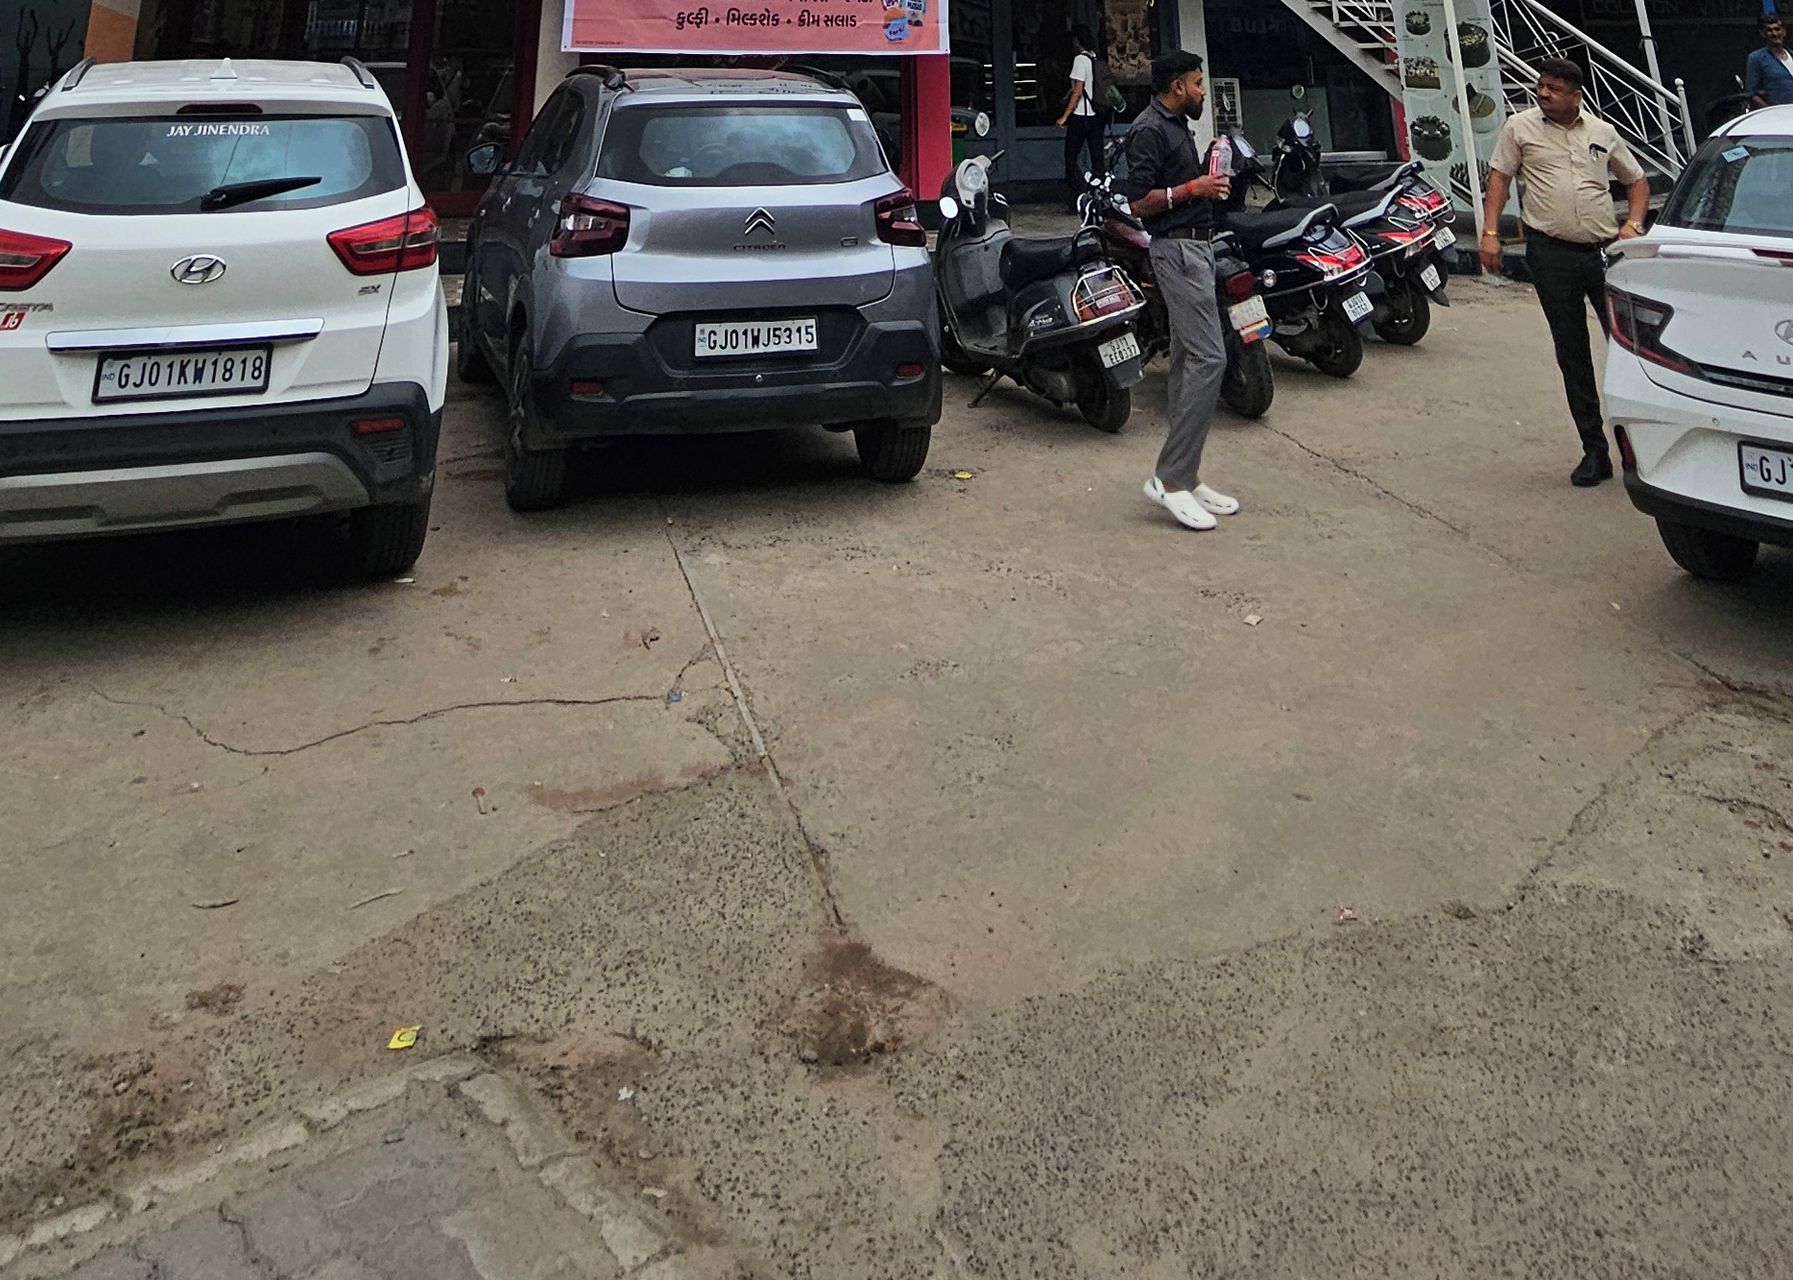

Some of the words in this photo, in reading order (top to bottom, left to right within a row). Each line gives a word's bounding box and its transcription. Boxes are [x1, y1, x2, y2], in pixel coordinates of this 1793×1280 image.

[676, 12, 709, 30] કુલ્ફી
[726, 13, 780, 27] મિલ્કશેક
[824, 15, 857, 28] સલાડ
[166, 125, 192, 137] JAY
[193, 124, 270, 137] JINENDRA
[708, 325, 814, 350] GJ01WJ5315
[117, 355, 263, 389] GJ01KW1818
